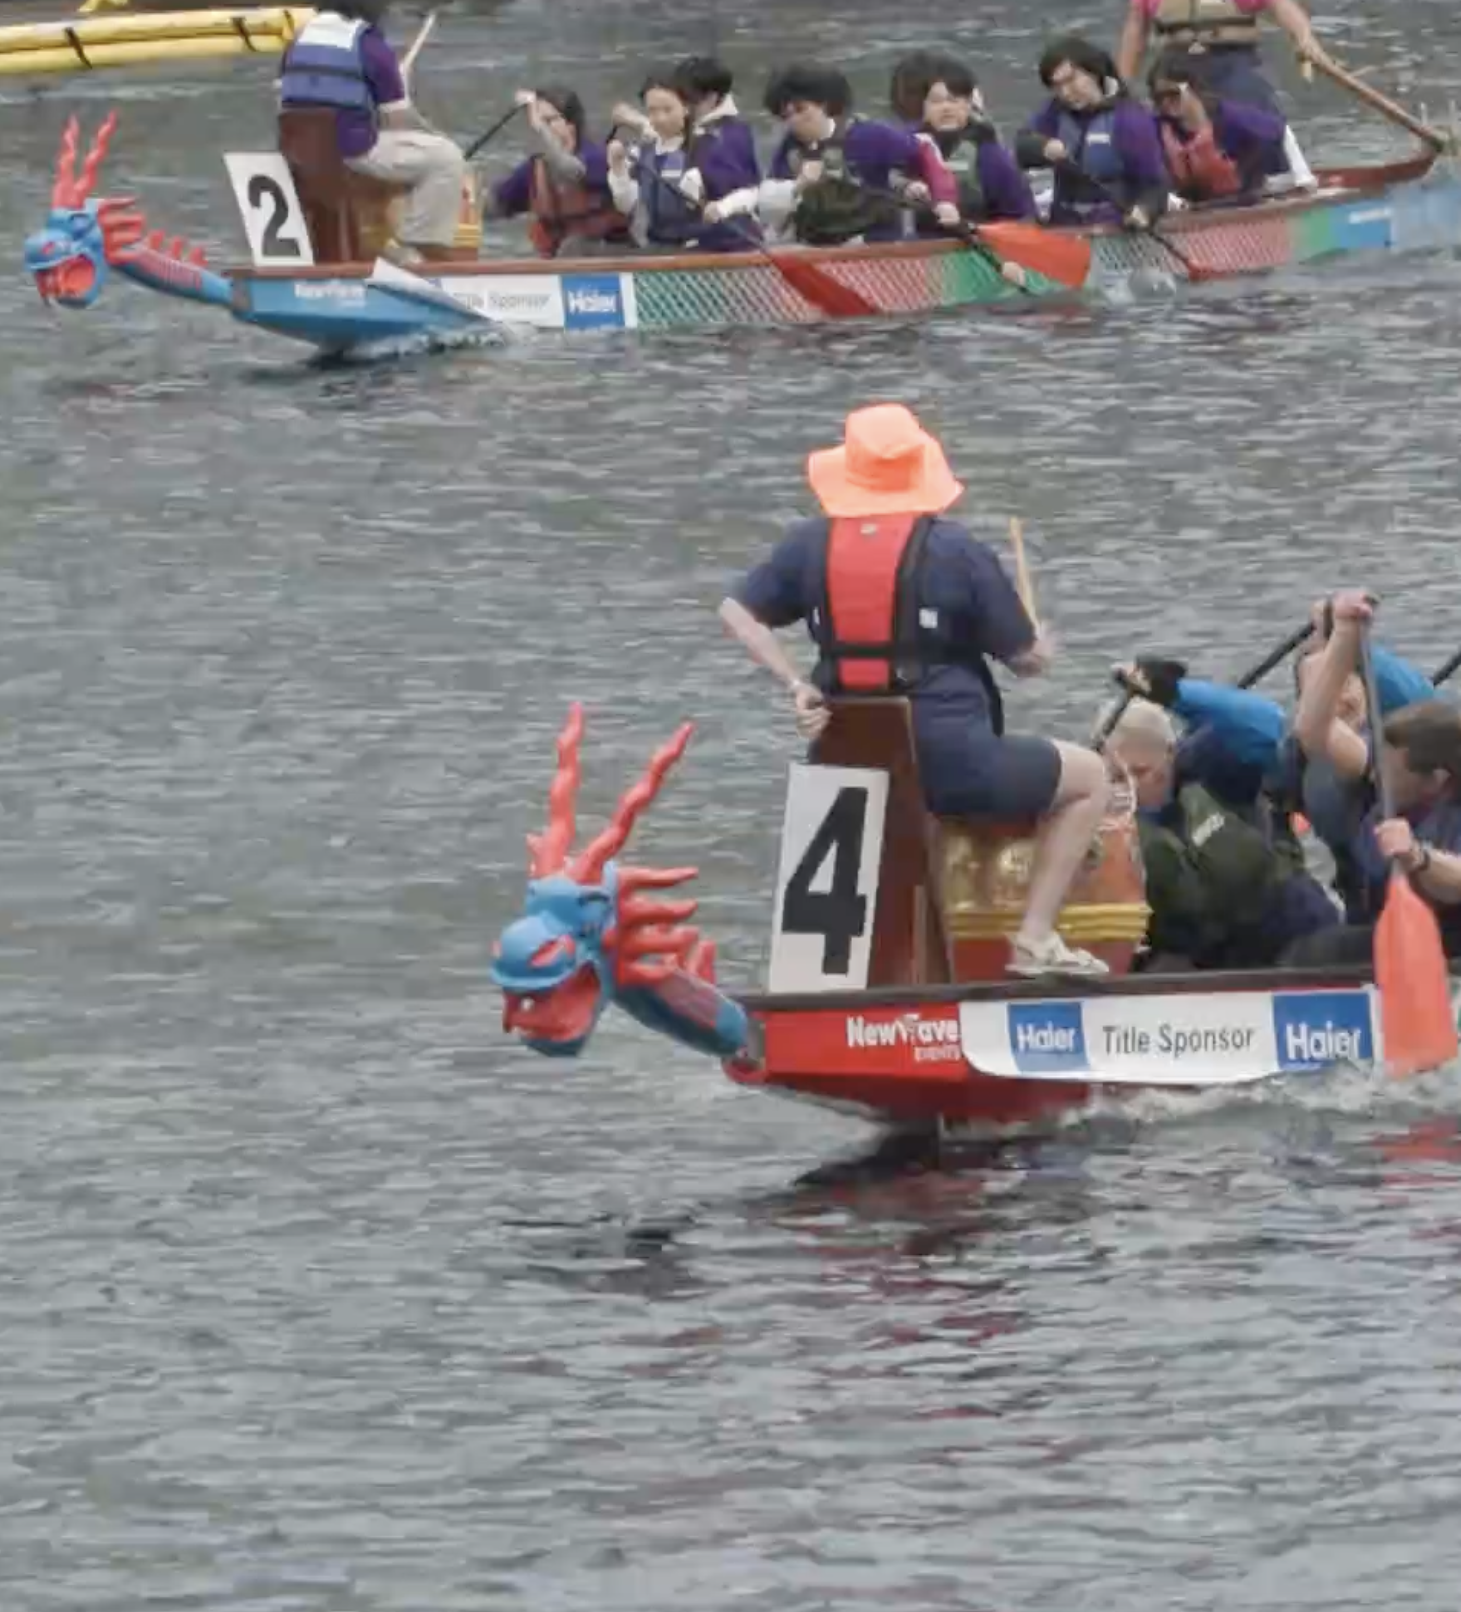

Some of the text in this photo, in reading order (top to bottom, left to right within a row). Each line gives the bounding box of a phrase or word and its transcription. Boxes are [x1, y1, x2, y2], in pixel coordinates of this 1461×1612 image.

[247, 173, 301, 257] 2
[781, 786, 868, 975] 4
[846, 1013, 959, 1047] NewWave
[1016, 1022, 1075, 1053] Haier
[1102, 1021, 1254, 1060] Title Sponsor
[1285, 1020, 1362, 1061] Haier
